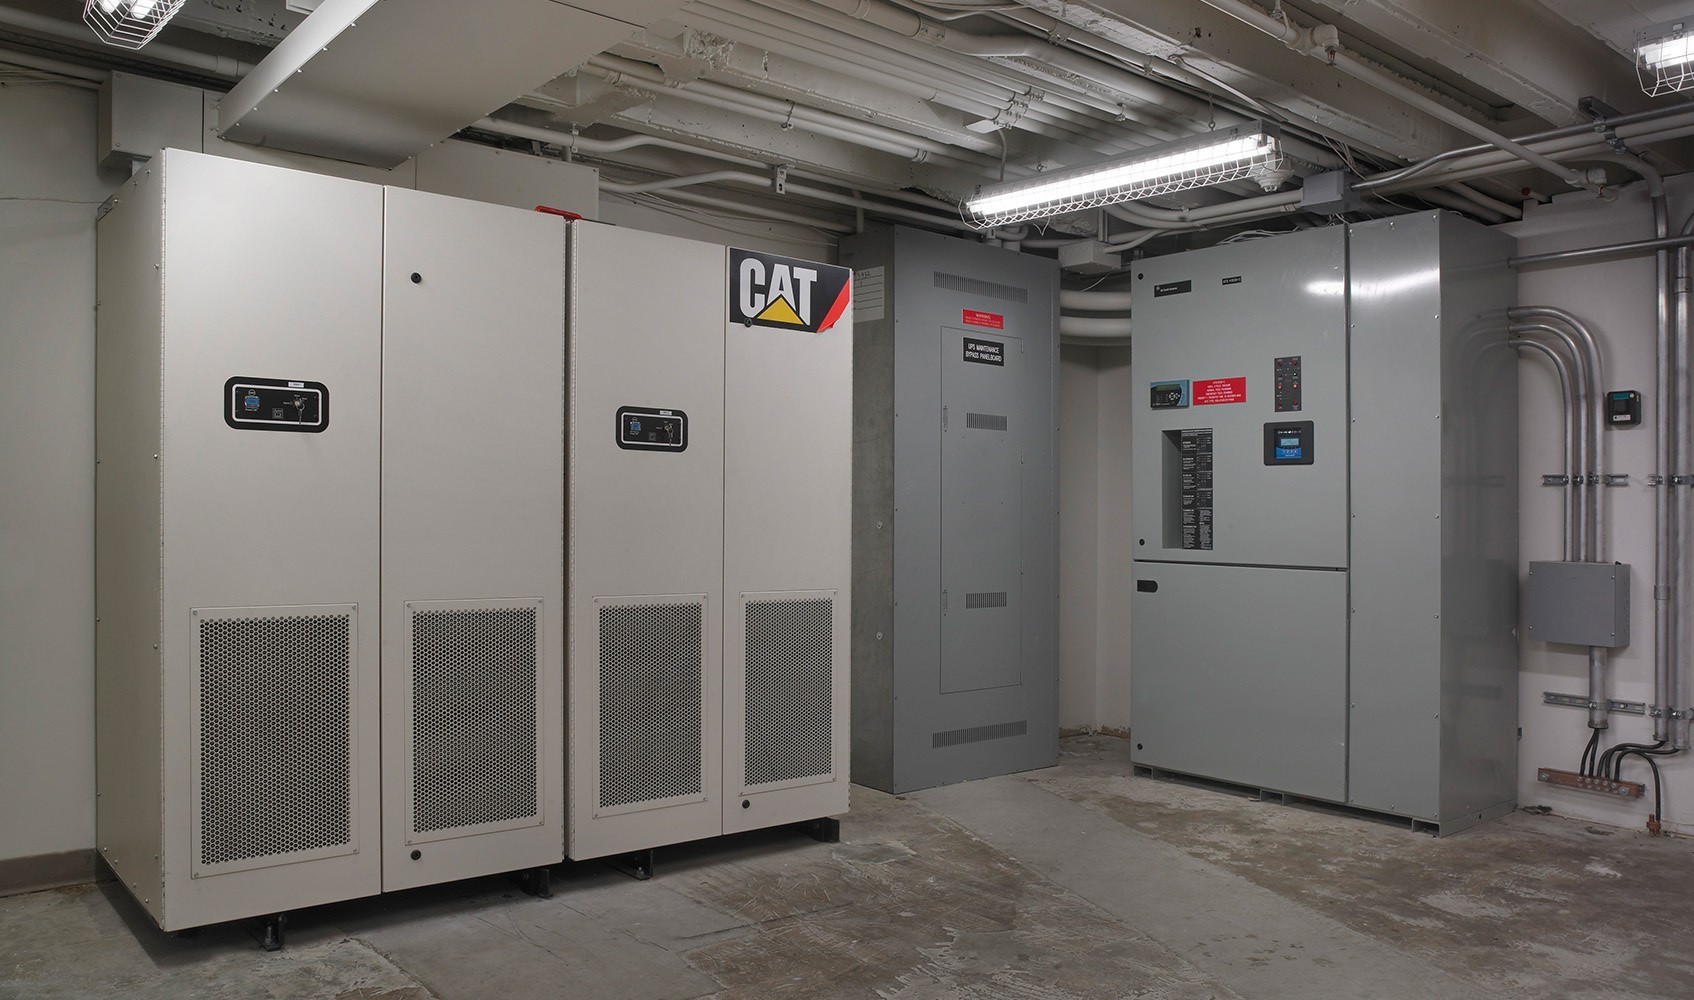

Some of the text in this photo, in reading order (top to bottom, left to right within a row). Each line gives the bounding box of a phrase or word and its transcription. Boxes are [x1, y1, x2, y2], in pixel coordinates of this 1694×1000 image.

[740, 257, 818, 326] CAT
[976, 344, 999, 354] MAINTENANCE
[965, 350, 1002, 362] BYPASS PANELBOARD
